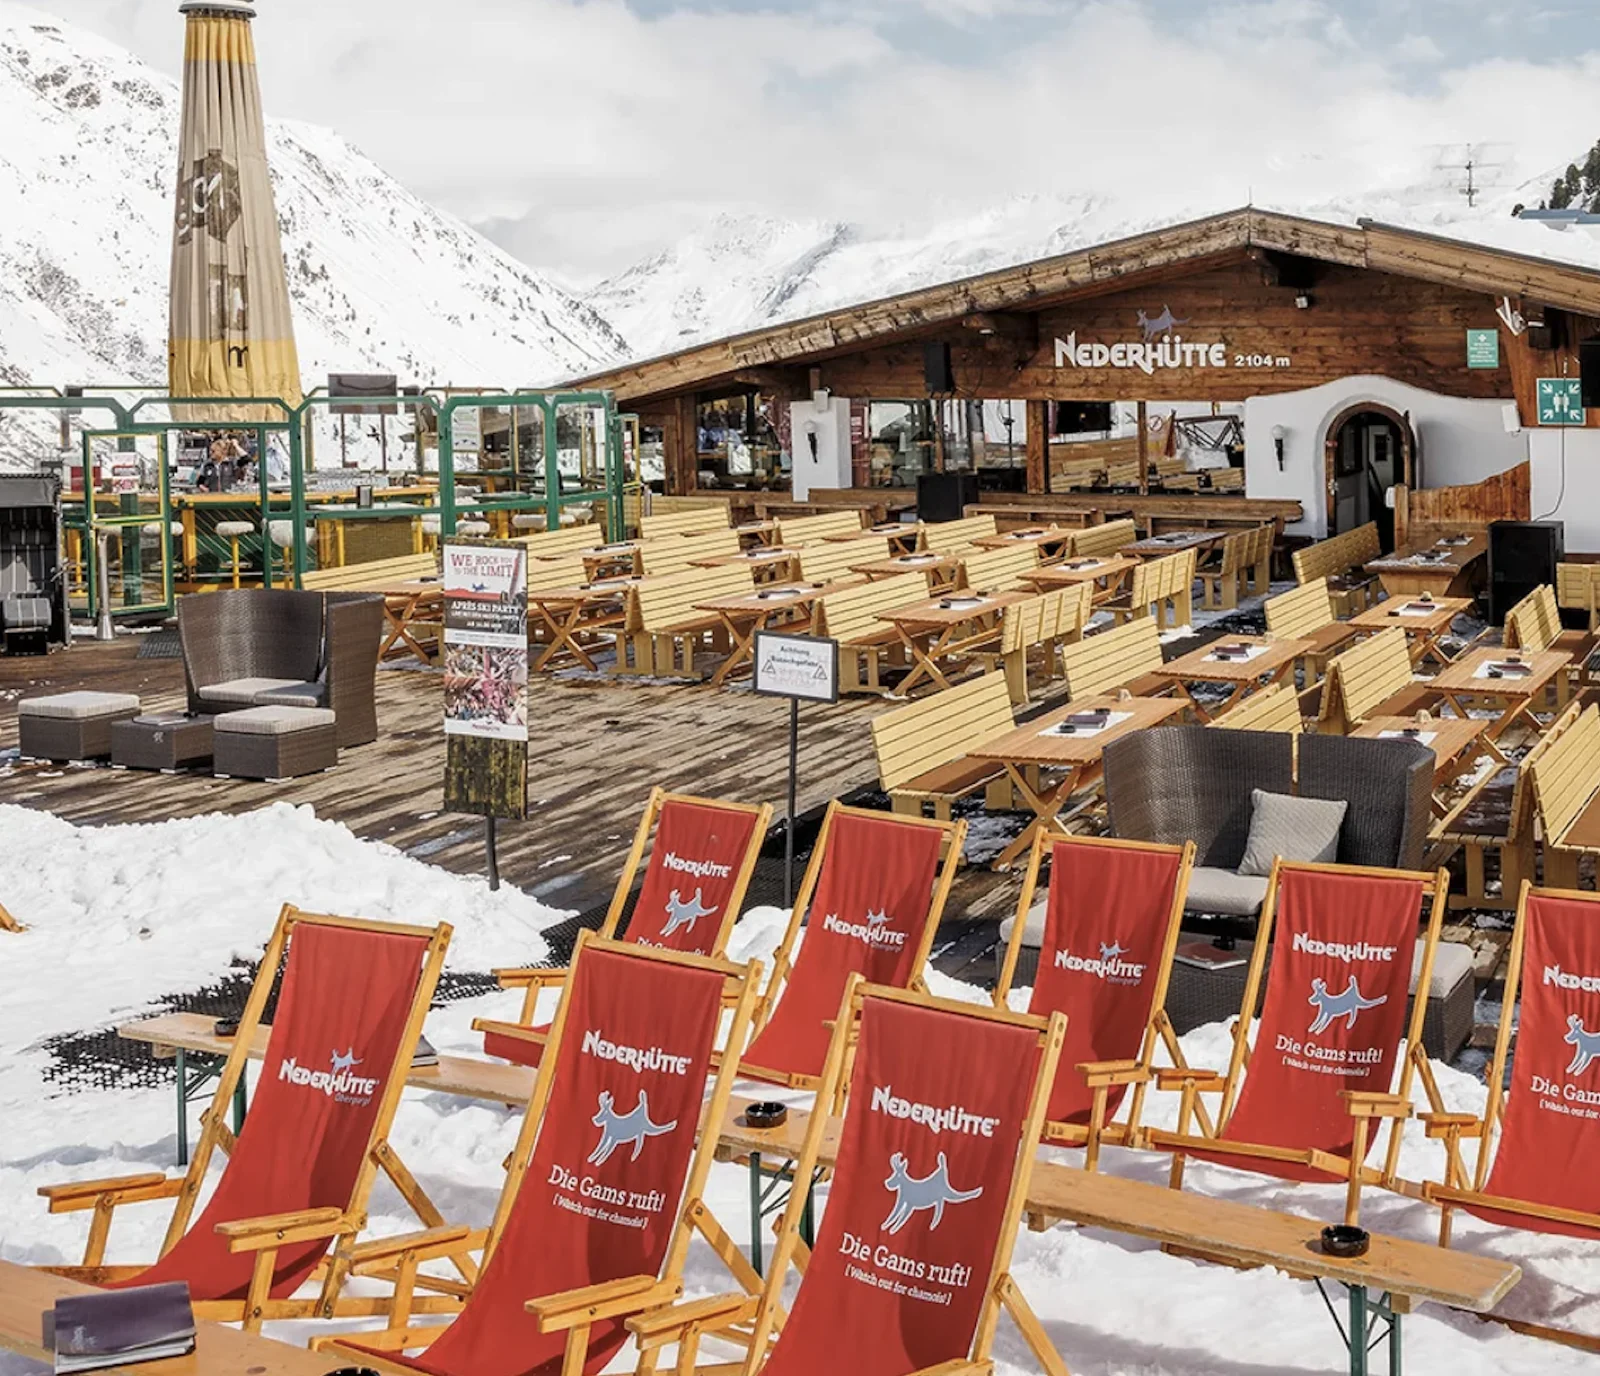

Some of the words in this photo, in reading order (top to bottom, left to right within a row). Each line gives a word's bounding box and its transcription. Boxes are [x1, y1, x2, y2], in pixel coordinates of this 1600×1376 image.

[1054, 330, 1226, 376] NEDERHÜTTE
[1234, 355, 1273, 368] 2104
[1275, 356, 1291, 368] m
[450, 553, 473, 567] WE
[475, 555, 499, 565] ROCK
[480, 564, 513, 577] LIMIT
[491, 603, 519, 614] PARTY
[780, 645, 810, 656] Achtung
[663, 851, 730, 878] NEDERHÜTTE
[823, 912, 906, 945] NEDERHÜTTE
[1292, 932, 1393, 963] NEDERHÜTTE
[1054, 948, 1143, 979] NEDERHÜTTE
[581, 1030, 690, 1075] NEDERHÜTTE
[1276, 1034, 1301, 1055] Die
[1303, 1042, 1347, 1062] Gams
[1347, 1048, 1383, 1064] ruft!
[278, 1057, 376, 1096] NEDERHÜTTE
[1530, 1075, 1560, 1098] Die
[870, 1085, 995, 1138] NEDERHÜTTE
[547, 1164, 578, 1192] Die
[580, 1176, 627, 1206] Gams
[626, 1189, 666, 1212] ruft!
[839, 1232, 871, 1261] Die
[873, 1245, 925, 1278] Gams
[926, 1262, 972, 1287] ruft!
[878, 1278, 893, 1290] out
[893, 1281, 908, 1295] for
